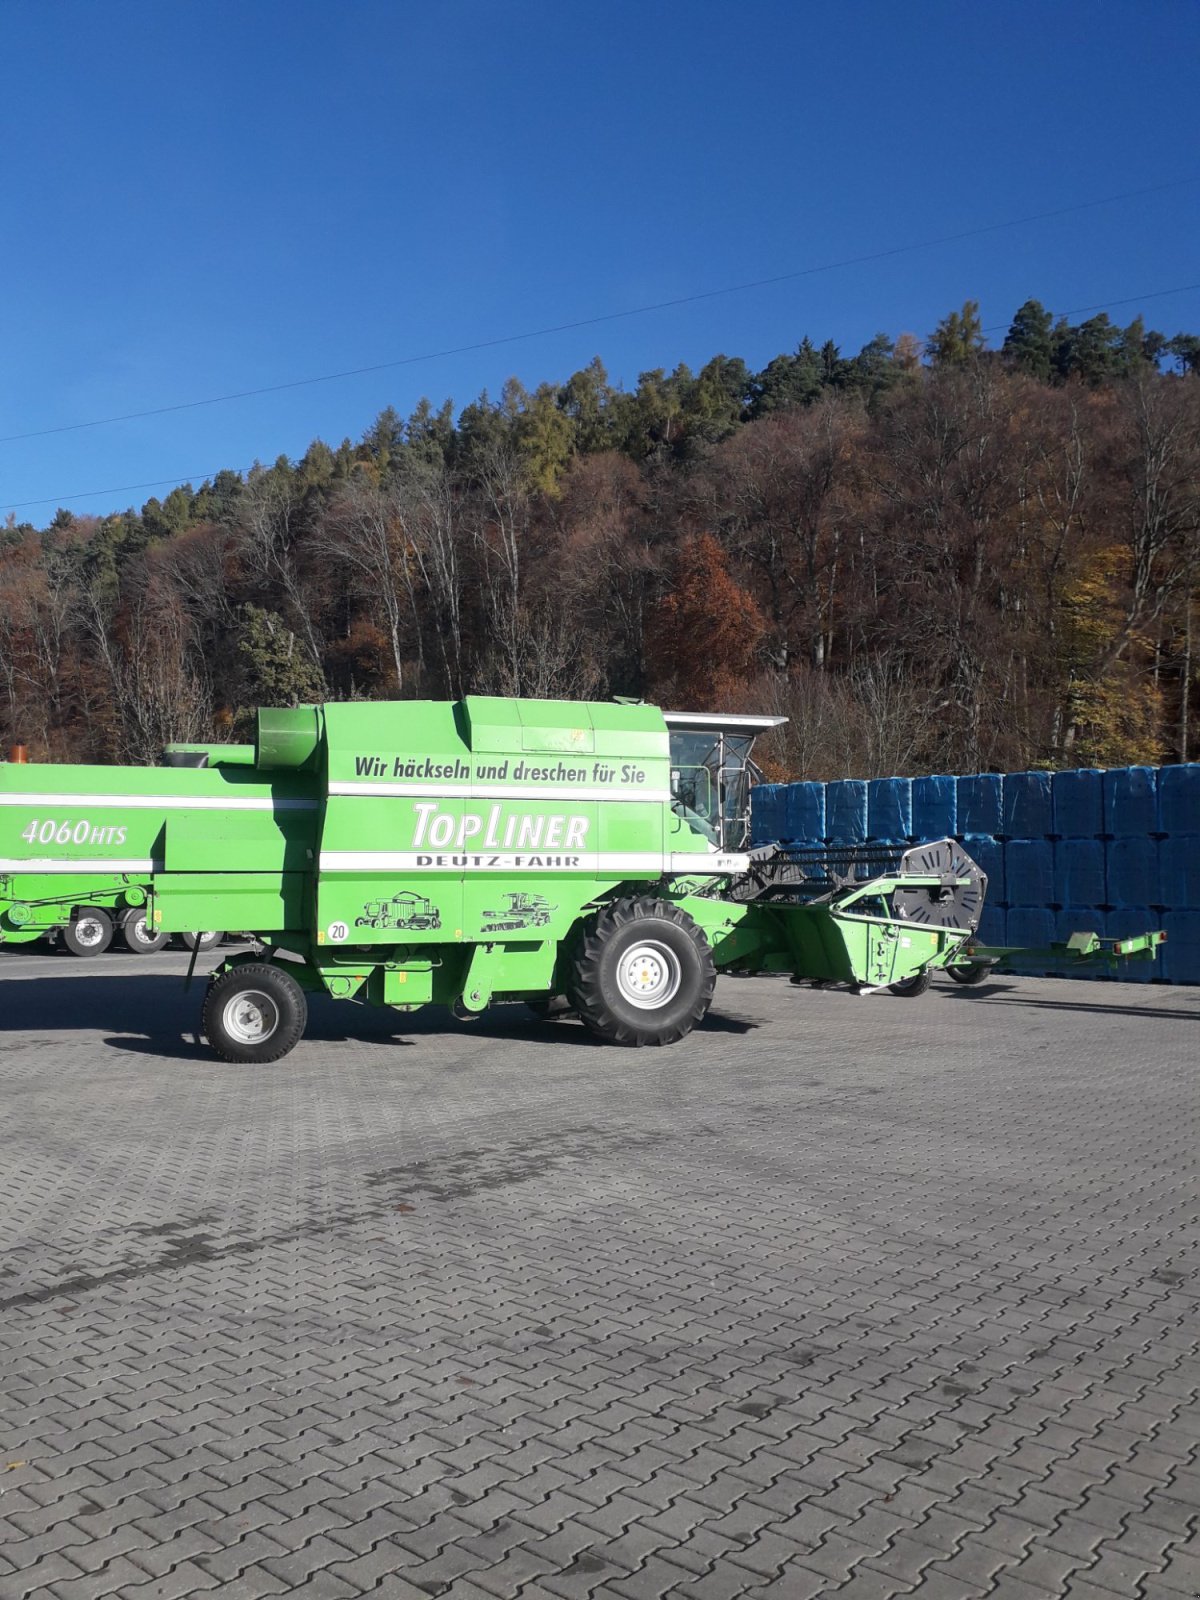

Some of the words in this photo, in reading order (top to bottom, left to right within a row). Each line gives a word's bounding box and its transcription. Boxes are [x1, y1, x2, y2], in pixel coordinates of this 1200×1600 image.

[355, 756, 388, 777] Wir
[393, 756, 471, 779] häckseln
[476, 760, 509, 780] und
[513, 760, 587, 782] dreschen
[592, 763, 616, 783] für
[620, 764, 646, 784] Sie
[416, 855, 580, 867] DEUTZ-FAHR
[332, 925, 346, 939] 20
